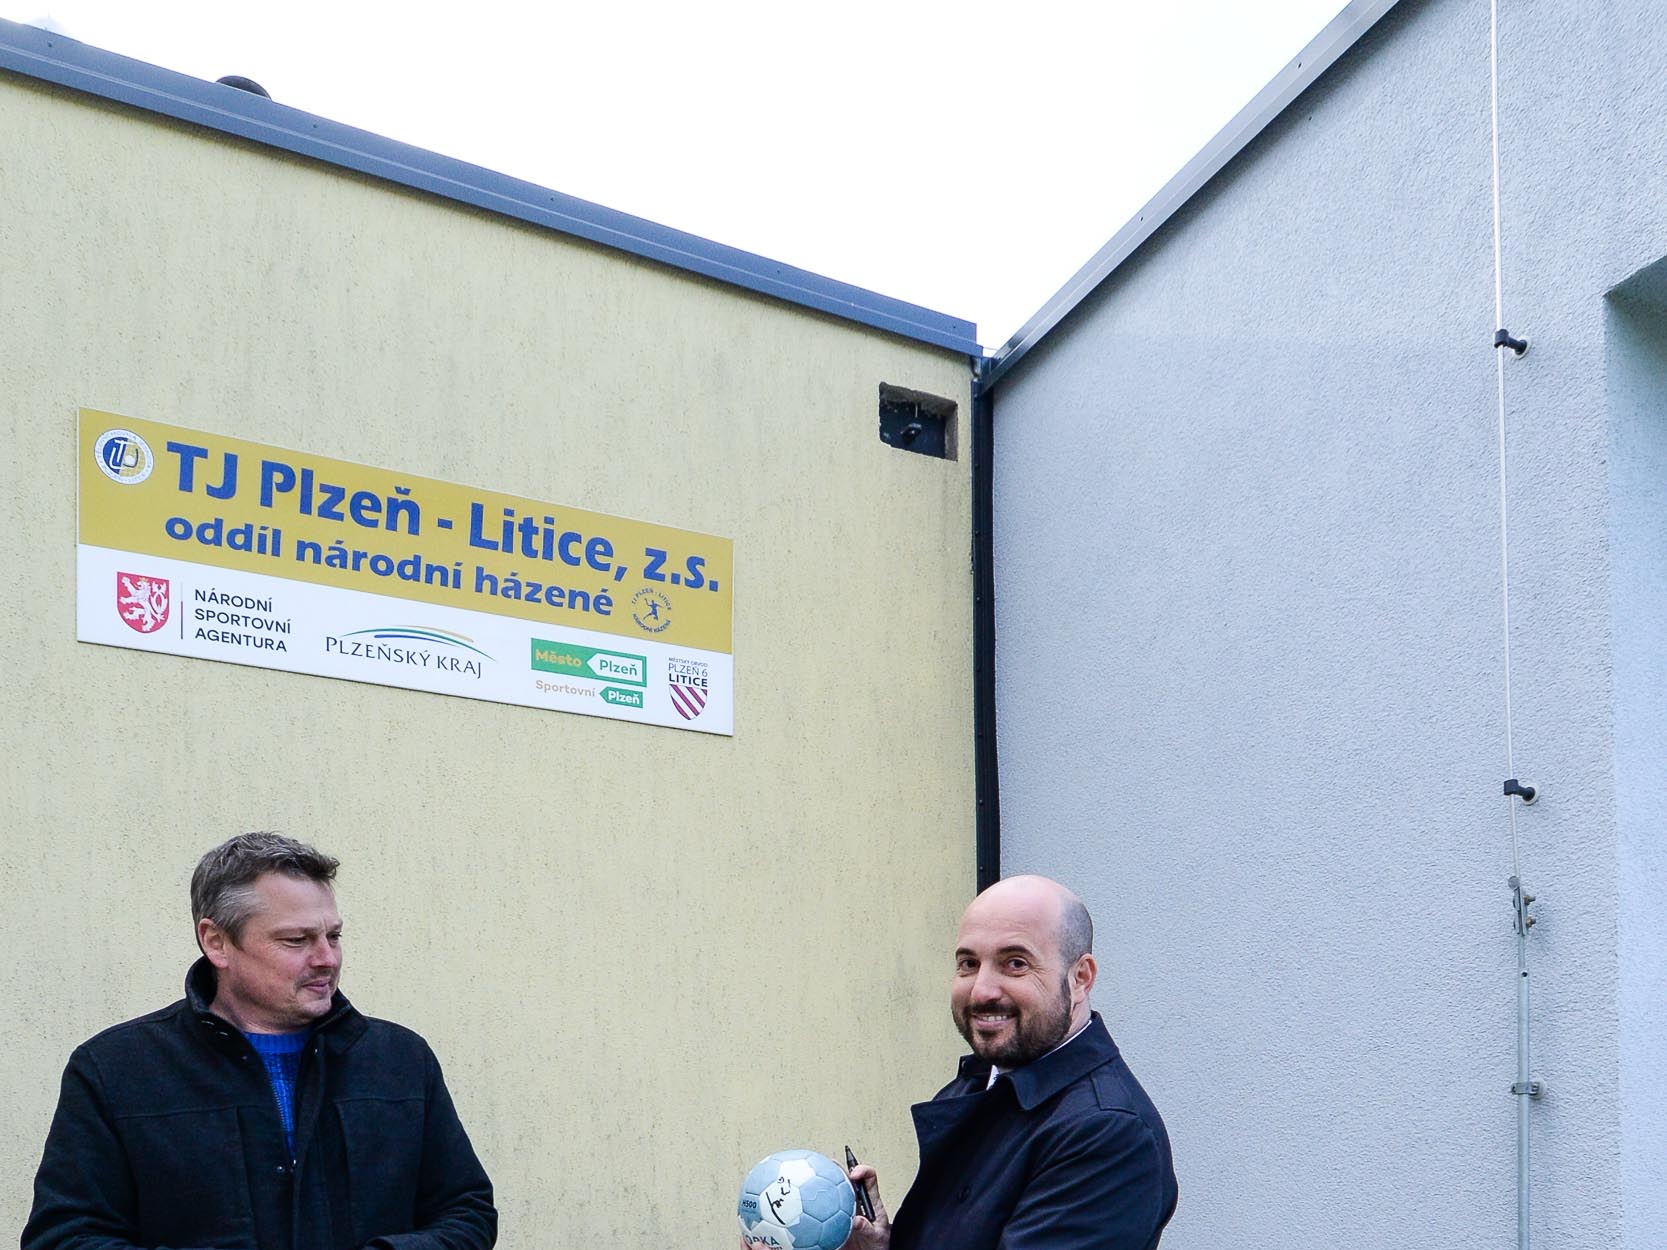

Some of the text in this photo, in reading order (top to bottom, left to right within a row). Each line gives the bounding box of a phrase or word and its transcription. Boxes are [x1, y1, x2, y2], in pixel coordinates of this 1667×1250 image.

[167, 441, 239, 499] TJ
[260, 460, 421, 536] Plzeň
[437, 518, 452, 530] -
[469, 502, 628, 582] Litice,
[643, 547, 719, 592] z.s.
[165, 516, 613, 616] oddíl národní házené
[195, 587, 272, 613] NÁRODNÍ
[195, 608, 291, 634] SPORTOVNÍ
[195, 628, 287, 652] AGENTURA
[326, 636, 482, 680] PLZEŇSKÝ KRAJ
[535, 648, 638, 677] Město Plzeň
[669, 662, 708, 678] PLZEŇ 6
[536, 679, 640, 705] Sportovní Plzeň
[669, 673, 708, 687] LITICE
